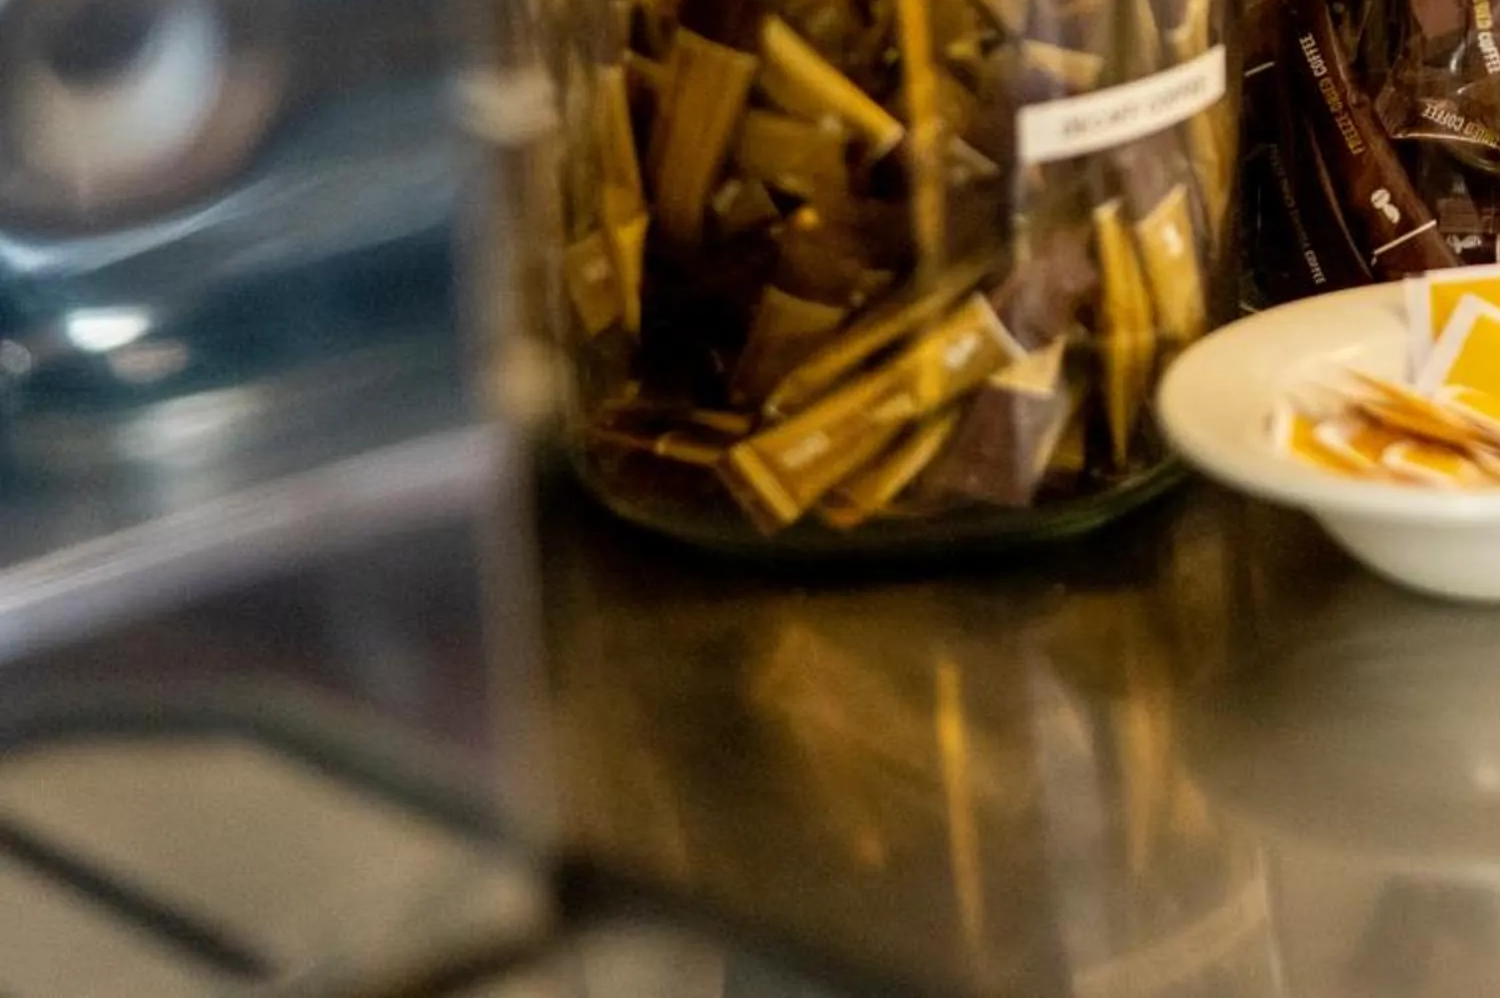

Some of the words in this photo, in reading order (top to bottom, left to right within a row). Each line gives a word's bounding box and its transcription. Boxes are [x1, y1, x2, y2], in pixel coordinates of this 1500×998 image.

[1300, 33, 1327, 77] COFFEE
[1422, 103, 1465, 131] COFFEE
[1304, 249, 1327, 285] COFFEE
